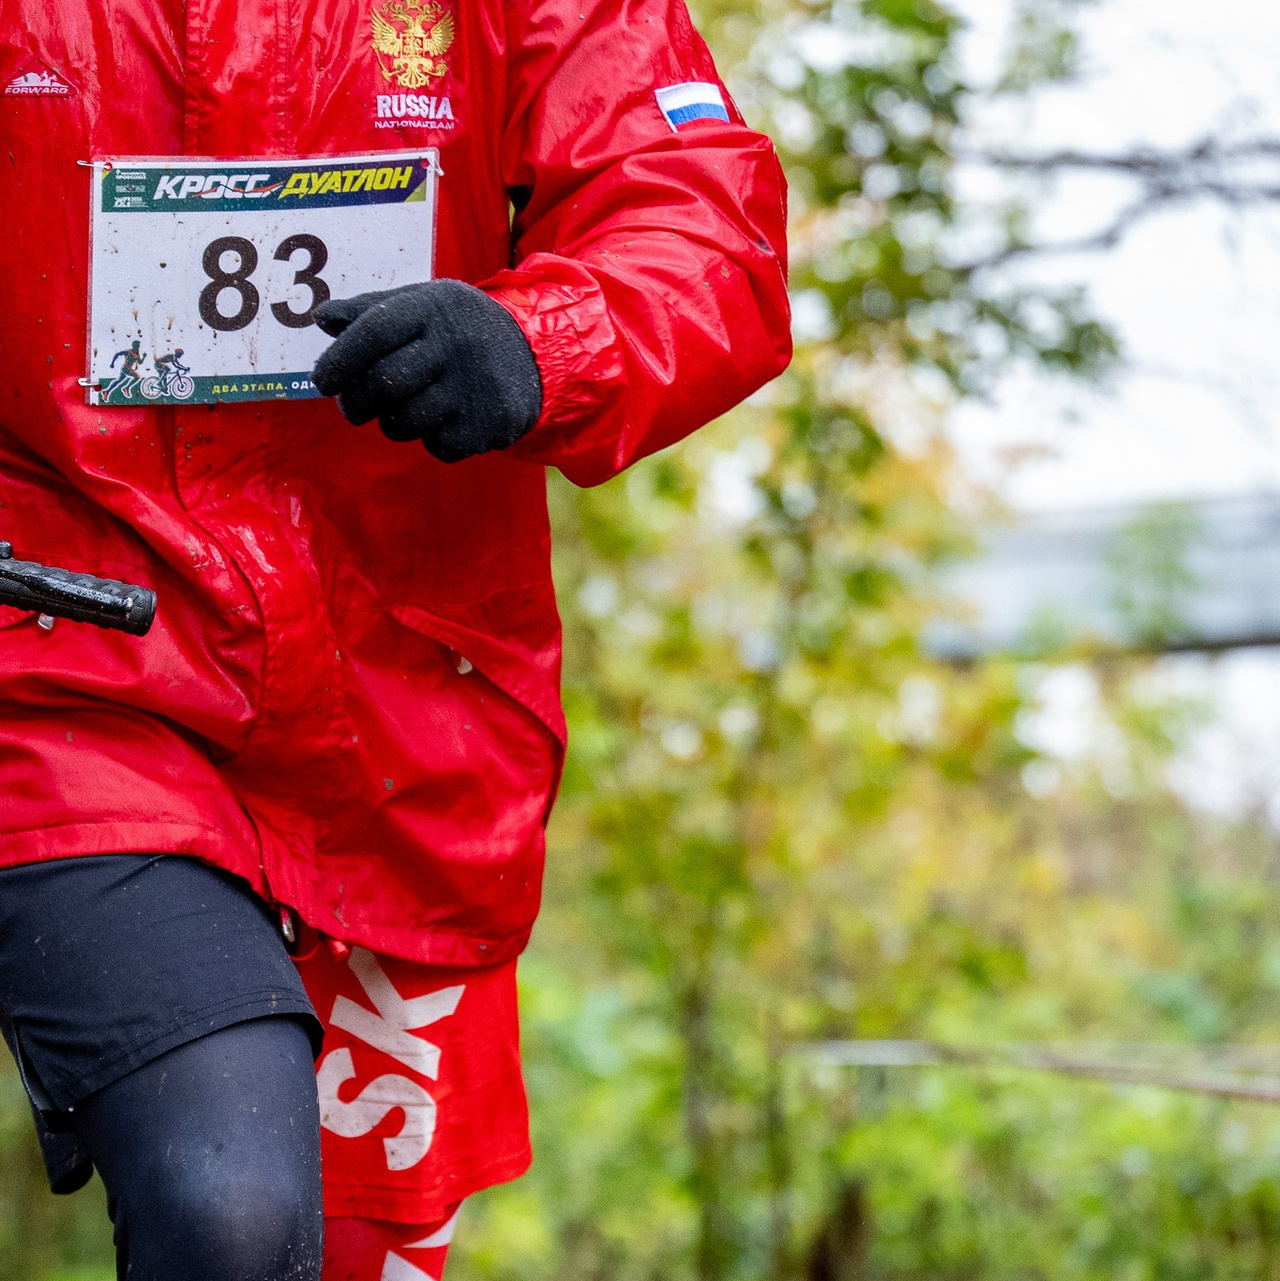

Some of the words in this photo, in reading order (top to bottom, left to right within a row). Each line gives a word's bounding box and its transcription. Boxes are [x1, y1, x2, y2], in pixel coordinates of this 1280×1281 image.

[4, 86, 69, 95] FORWARD
[376, 93, 455, 120] RUSSIA
[153, 174, 276, 201] КРОСС
[278, 166, 412, 200] ДУАТЛОН
[198, 233, 331, 332] 83
[211, 384, 239, 395] ДВА
[241, 381, 289, 393] ЭТАПА.
